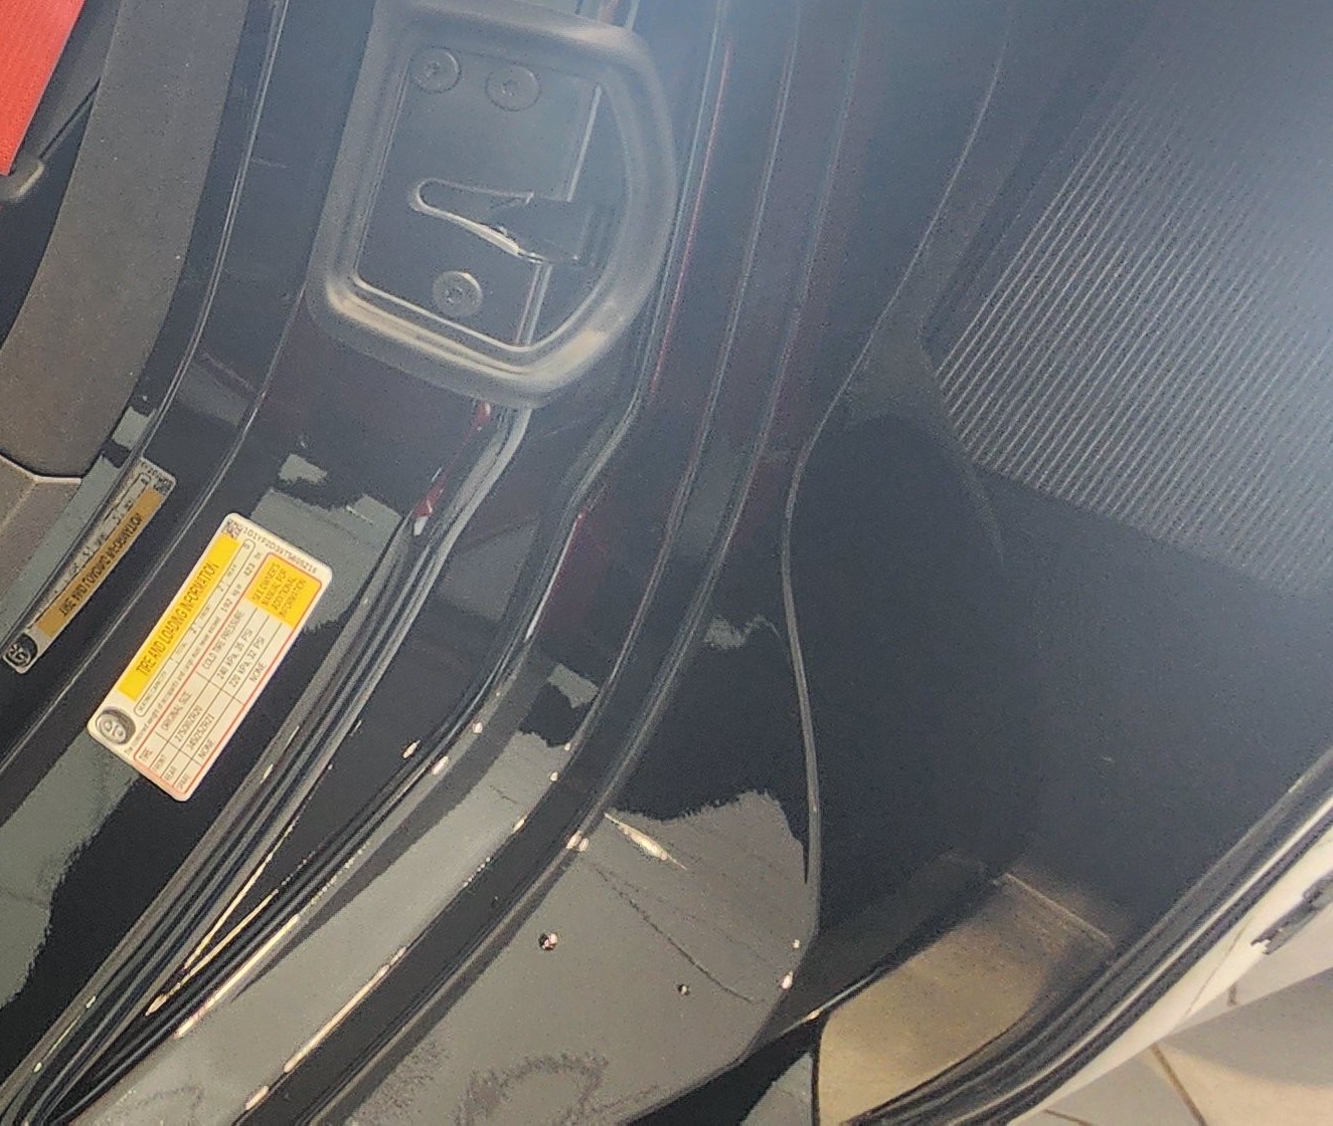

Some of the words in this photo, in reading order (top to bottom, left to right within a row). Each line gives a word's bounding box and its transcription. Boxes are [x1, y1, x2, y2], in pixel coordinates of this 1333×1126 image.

[220, 597, 233, 612] 192
[242, 561, 255, 577] 423
[134, 654, 156, 677] TIRE
[146, 639, 167, 660] AND
[157, 606, 189, 644] LOADING
[178, 559, 220, 612] INFORMATION
[201, 651, 217, 670] COLD
[211, 639, 225, 654] TIRE
[219, 608, 245, 641] PRESSURE
[234, 640, 245, 652] 35
[240, 627, 254, 642] PSI
[252, 635, 266, 650] PSI
[248, 660, 267, 683] NONE
[159, 702, 184, 732] ORIGINAL
[177, 689, 192, 705] SIZE
[197, 737, 215, 759] NONE
